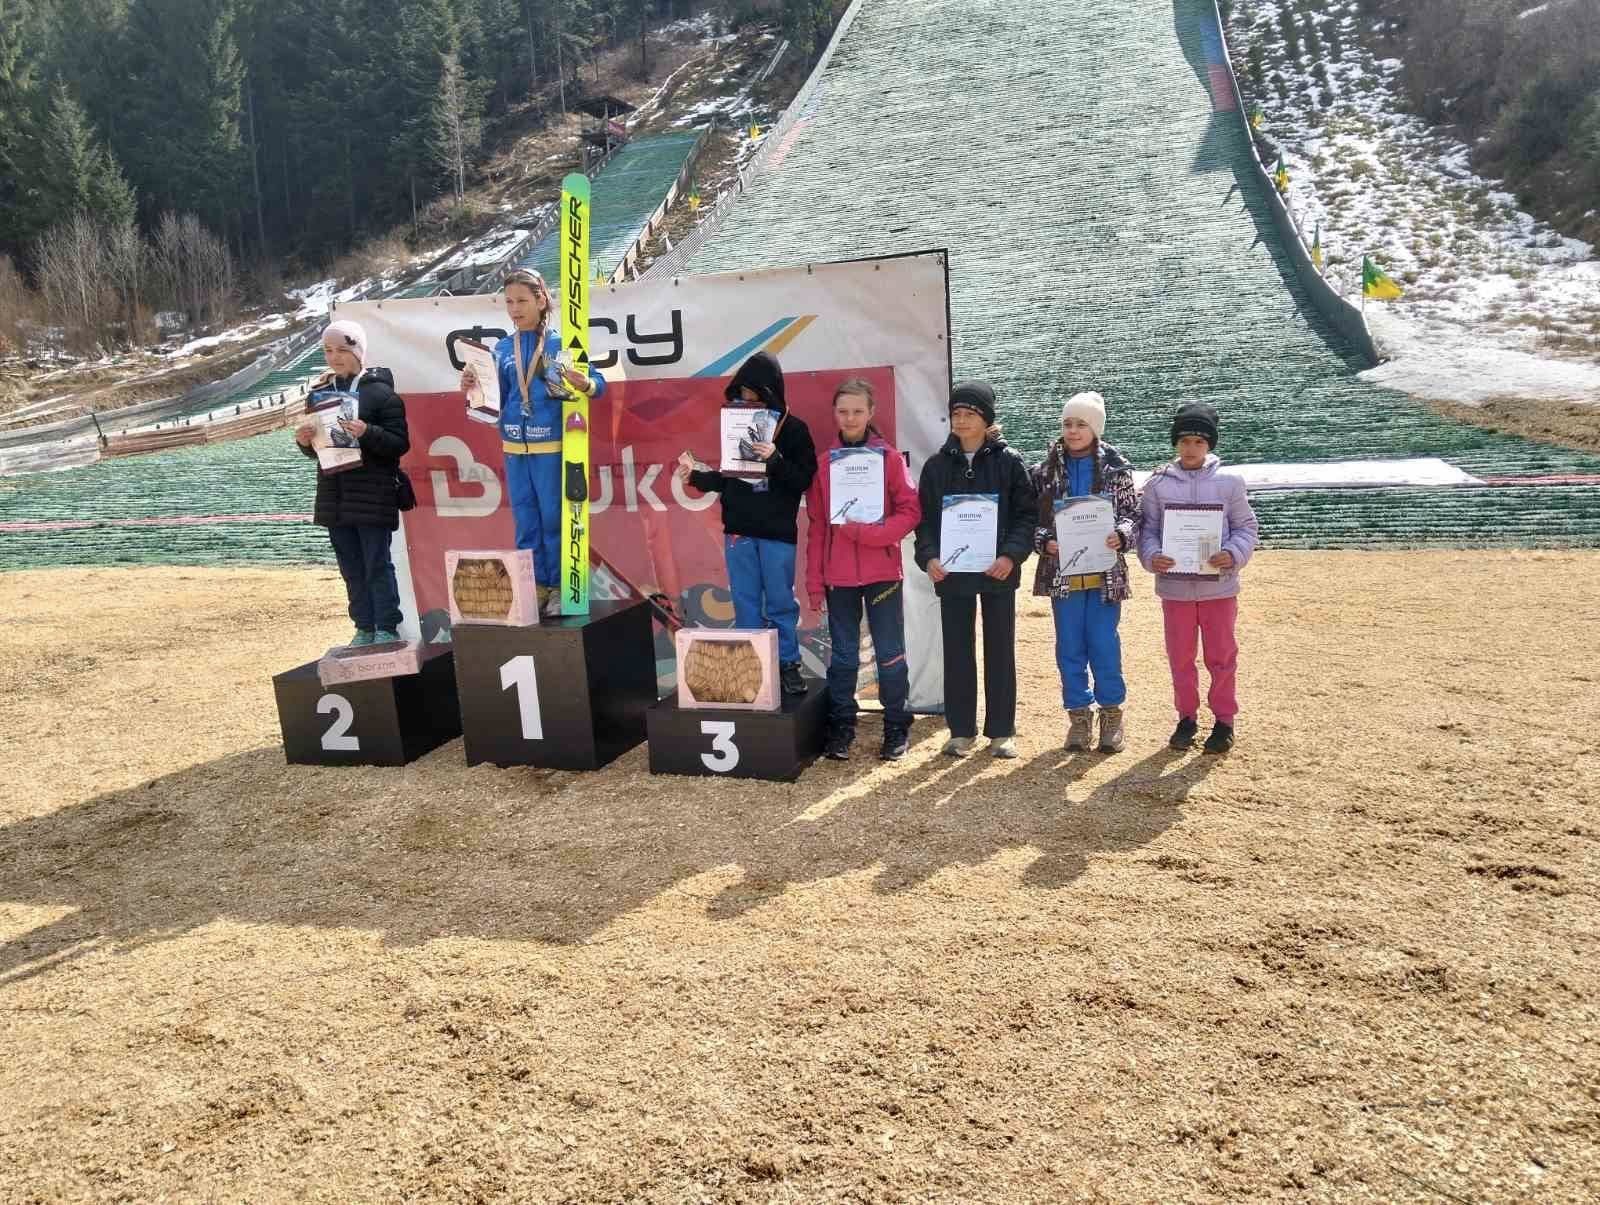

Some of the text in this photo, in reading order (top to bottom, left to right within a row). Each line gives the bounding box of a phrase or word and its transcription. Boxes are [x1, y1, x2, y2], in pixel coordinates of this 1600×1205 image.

[568, 196, 582, 330] FISCHER
[315, 693, 360, 751] 2
[500, 655, 544, 740] 1
[700, 721, 740, 773] 3
